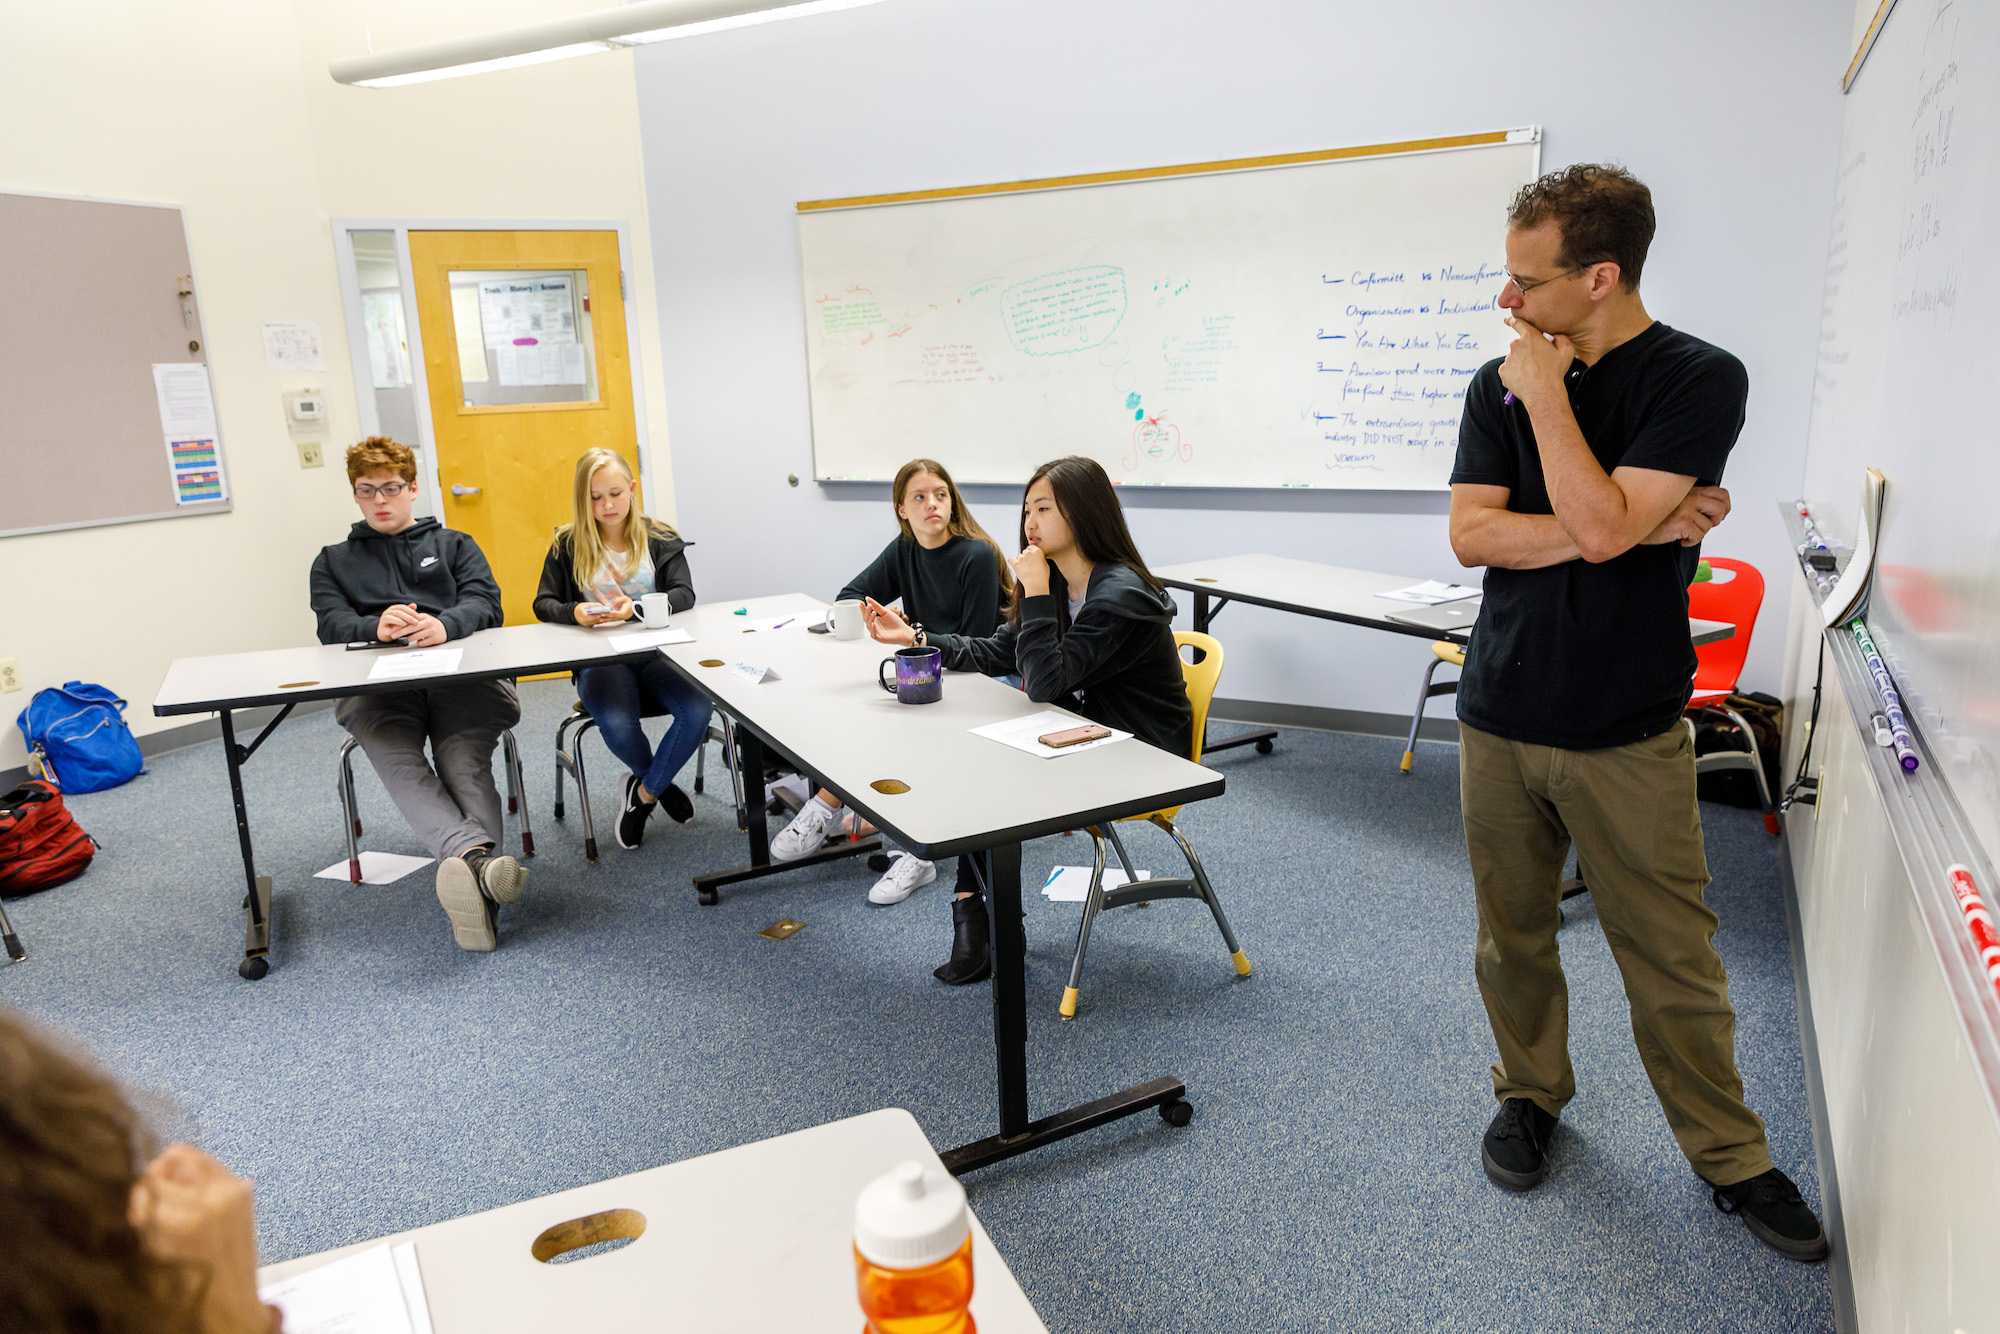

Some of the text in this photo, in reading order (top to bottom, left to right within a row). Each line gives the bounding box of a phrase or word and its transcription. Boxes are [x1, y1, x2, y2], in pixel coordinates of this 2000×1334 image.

[1422, 272, 1432, 281] vs
[1346, 294, 1498, 325] Organization vs Individual
[1354, 329, 1373, 348] You
[1401, 335, 1429, 350] What
[1435, 331, 1451, 350] You
[1455, 333, 1480, 350] Eat
[1423, 368, 1446, 376] more
[1391, 386, 1415, 398] than
[1421, 386, 1449, 407] higher
[1341, 412, 1358, 427] The
[1363, 431, 1381, 446] DID
[1382, 433, 1405, 446] NOT
[1434, 437, 1445, 447] in
